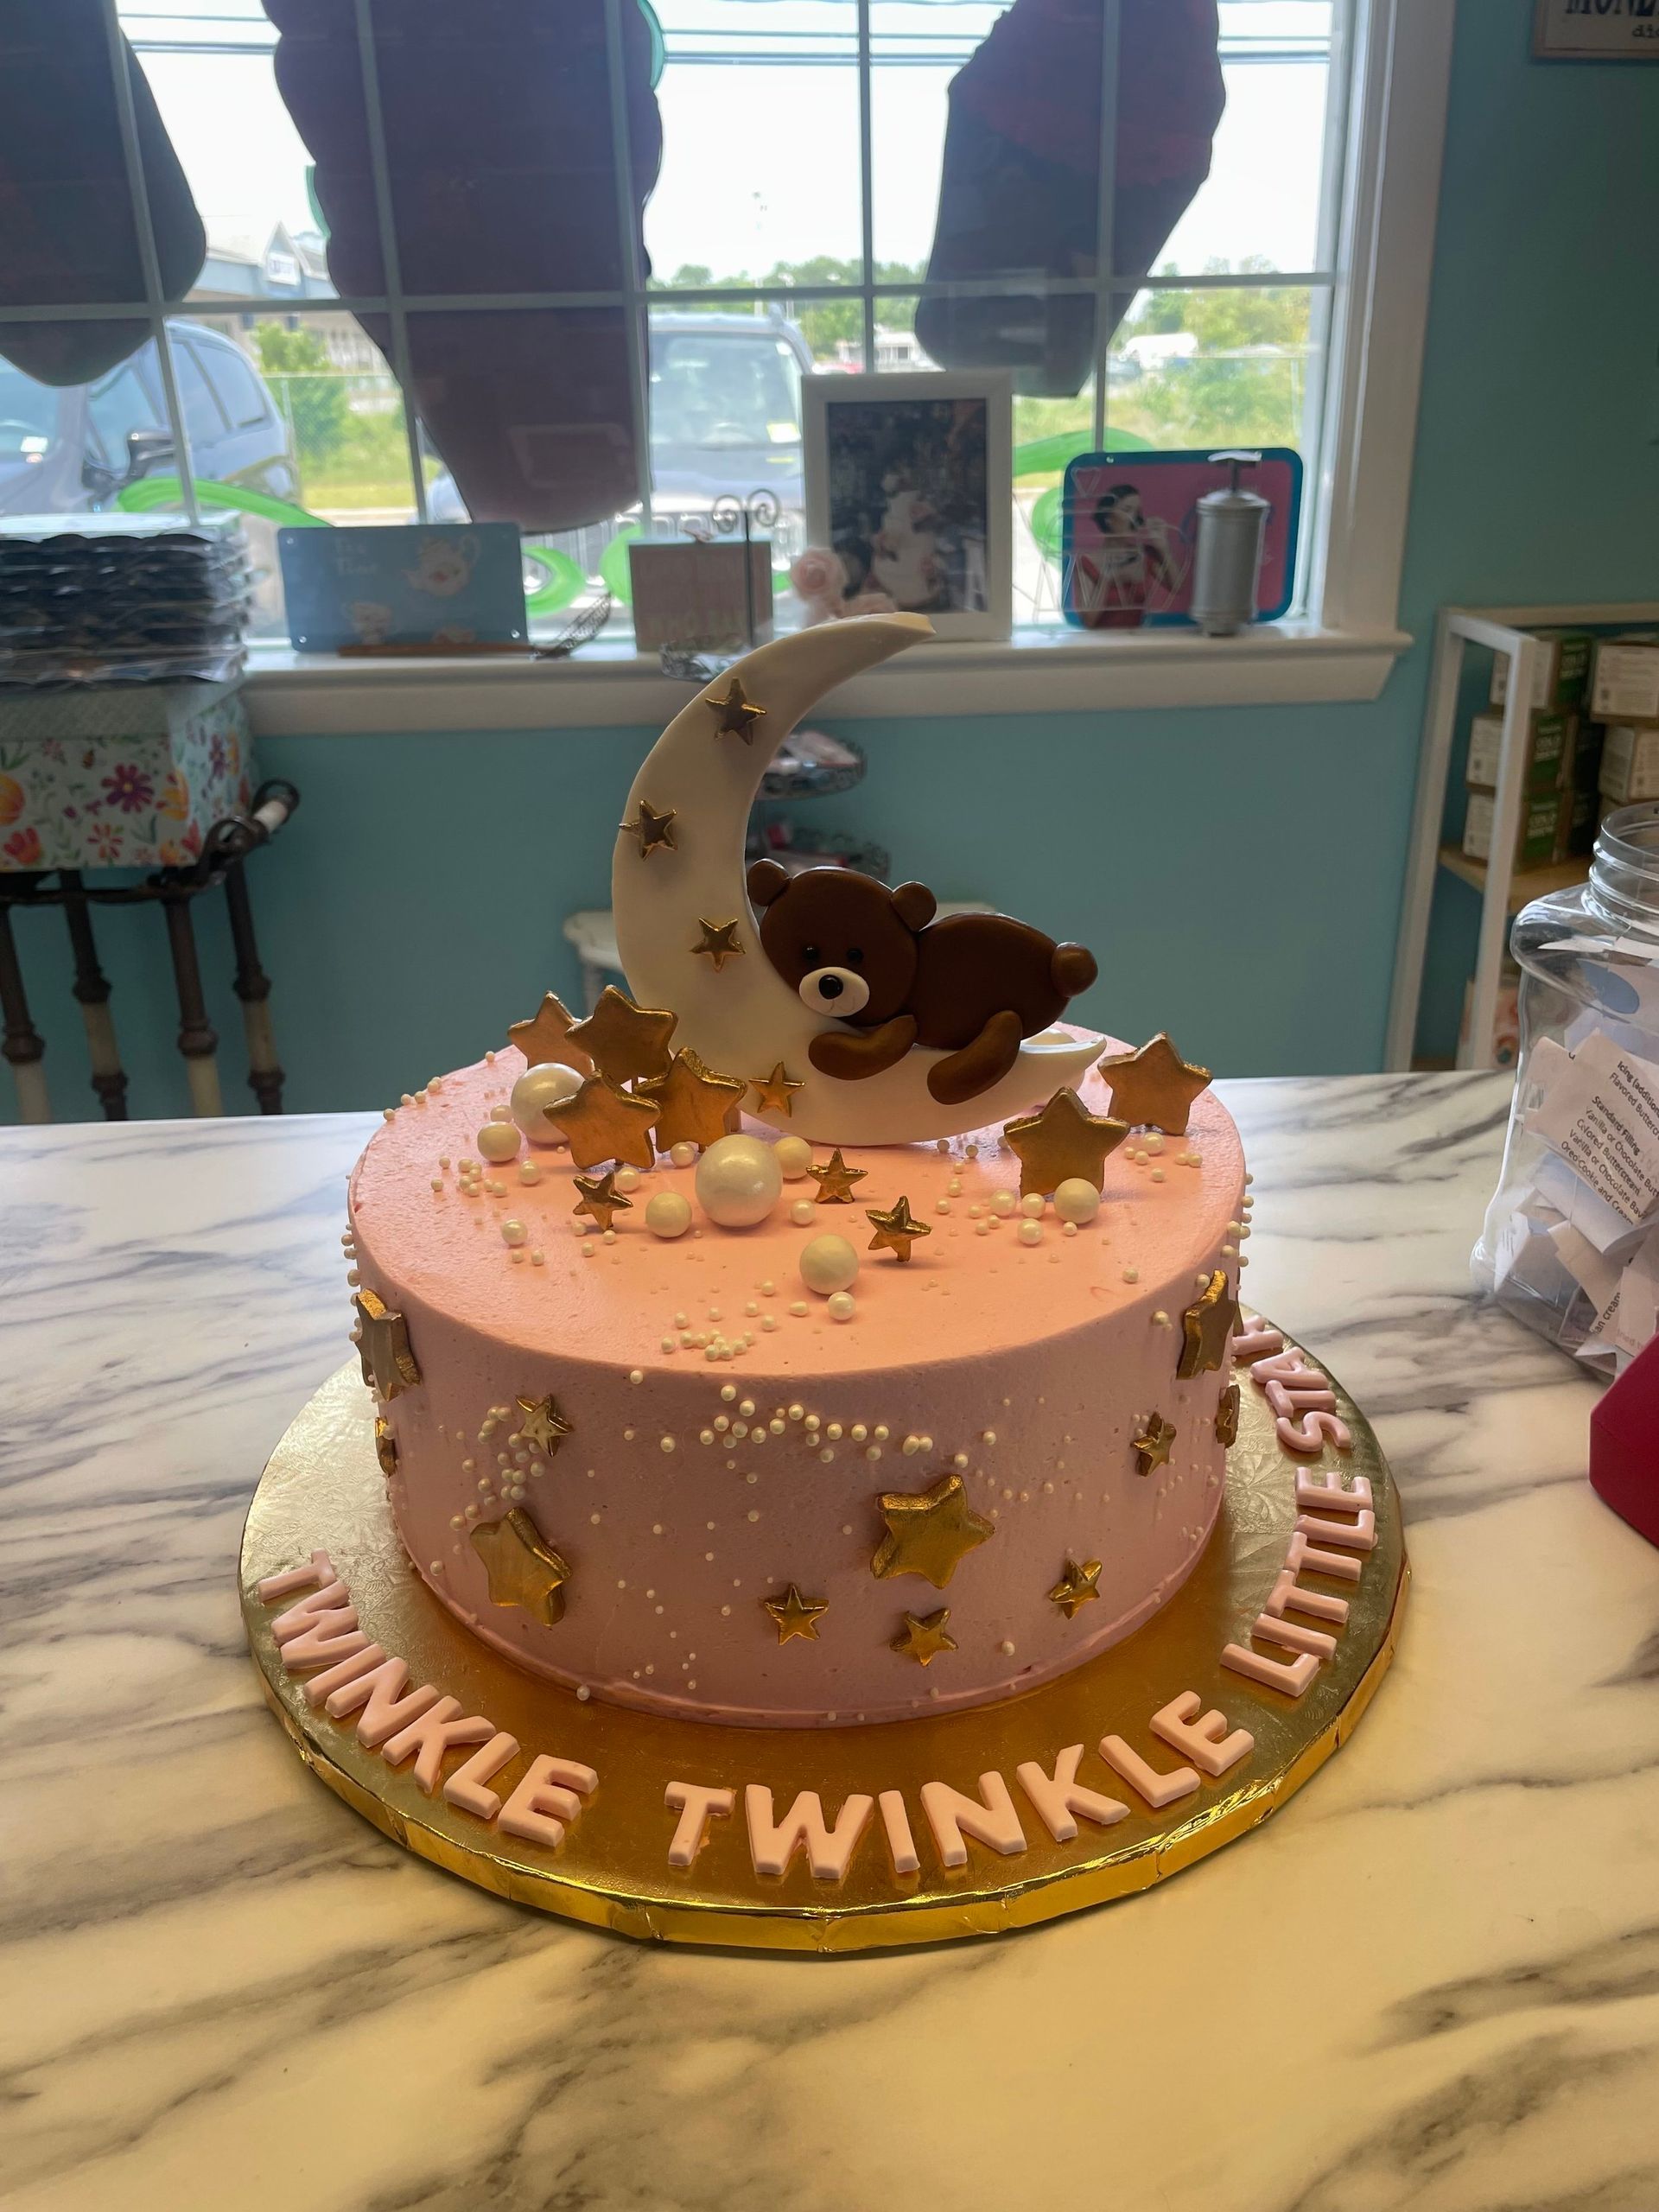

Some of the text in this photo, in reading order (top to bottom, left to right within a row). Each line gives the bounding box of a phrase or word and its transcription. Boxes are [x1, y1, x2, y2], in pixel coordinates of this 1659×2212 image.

[1609, 1072, 1638, 1106] Flavored
[1618, 1060, 1659, 1119] Icing (addition
[1592, 1096, 1640, 1156] Standard Filling
[1561, 1141, 1579, 1161] Oreo
[1578, 1160, 1599, 1187] Cookie
[1598, 1186, 1613, 1203] and
[1591, 1155, 1599, 1165] or
[1599, 1164, 1630, 1204] Chocolate
[1602, 1147, 1641, 1196] Buttercream
[1606, 1133, 1616, 1143] or
[1615, 1141, 1645, 1181] Chocolate
[259, 1548, 599, 1847] TWINKLE
[664, 1689, 1255, 1880] TWINKLE
[1220, 1466, 1378, 1697] LITTLE
